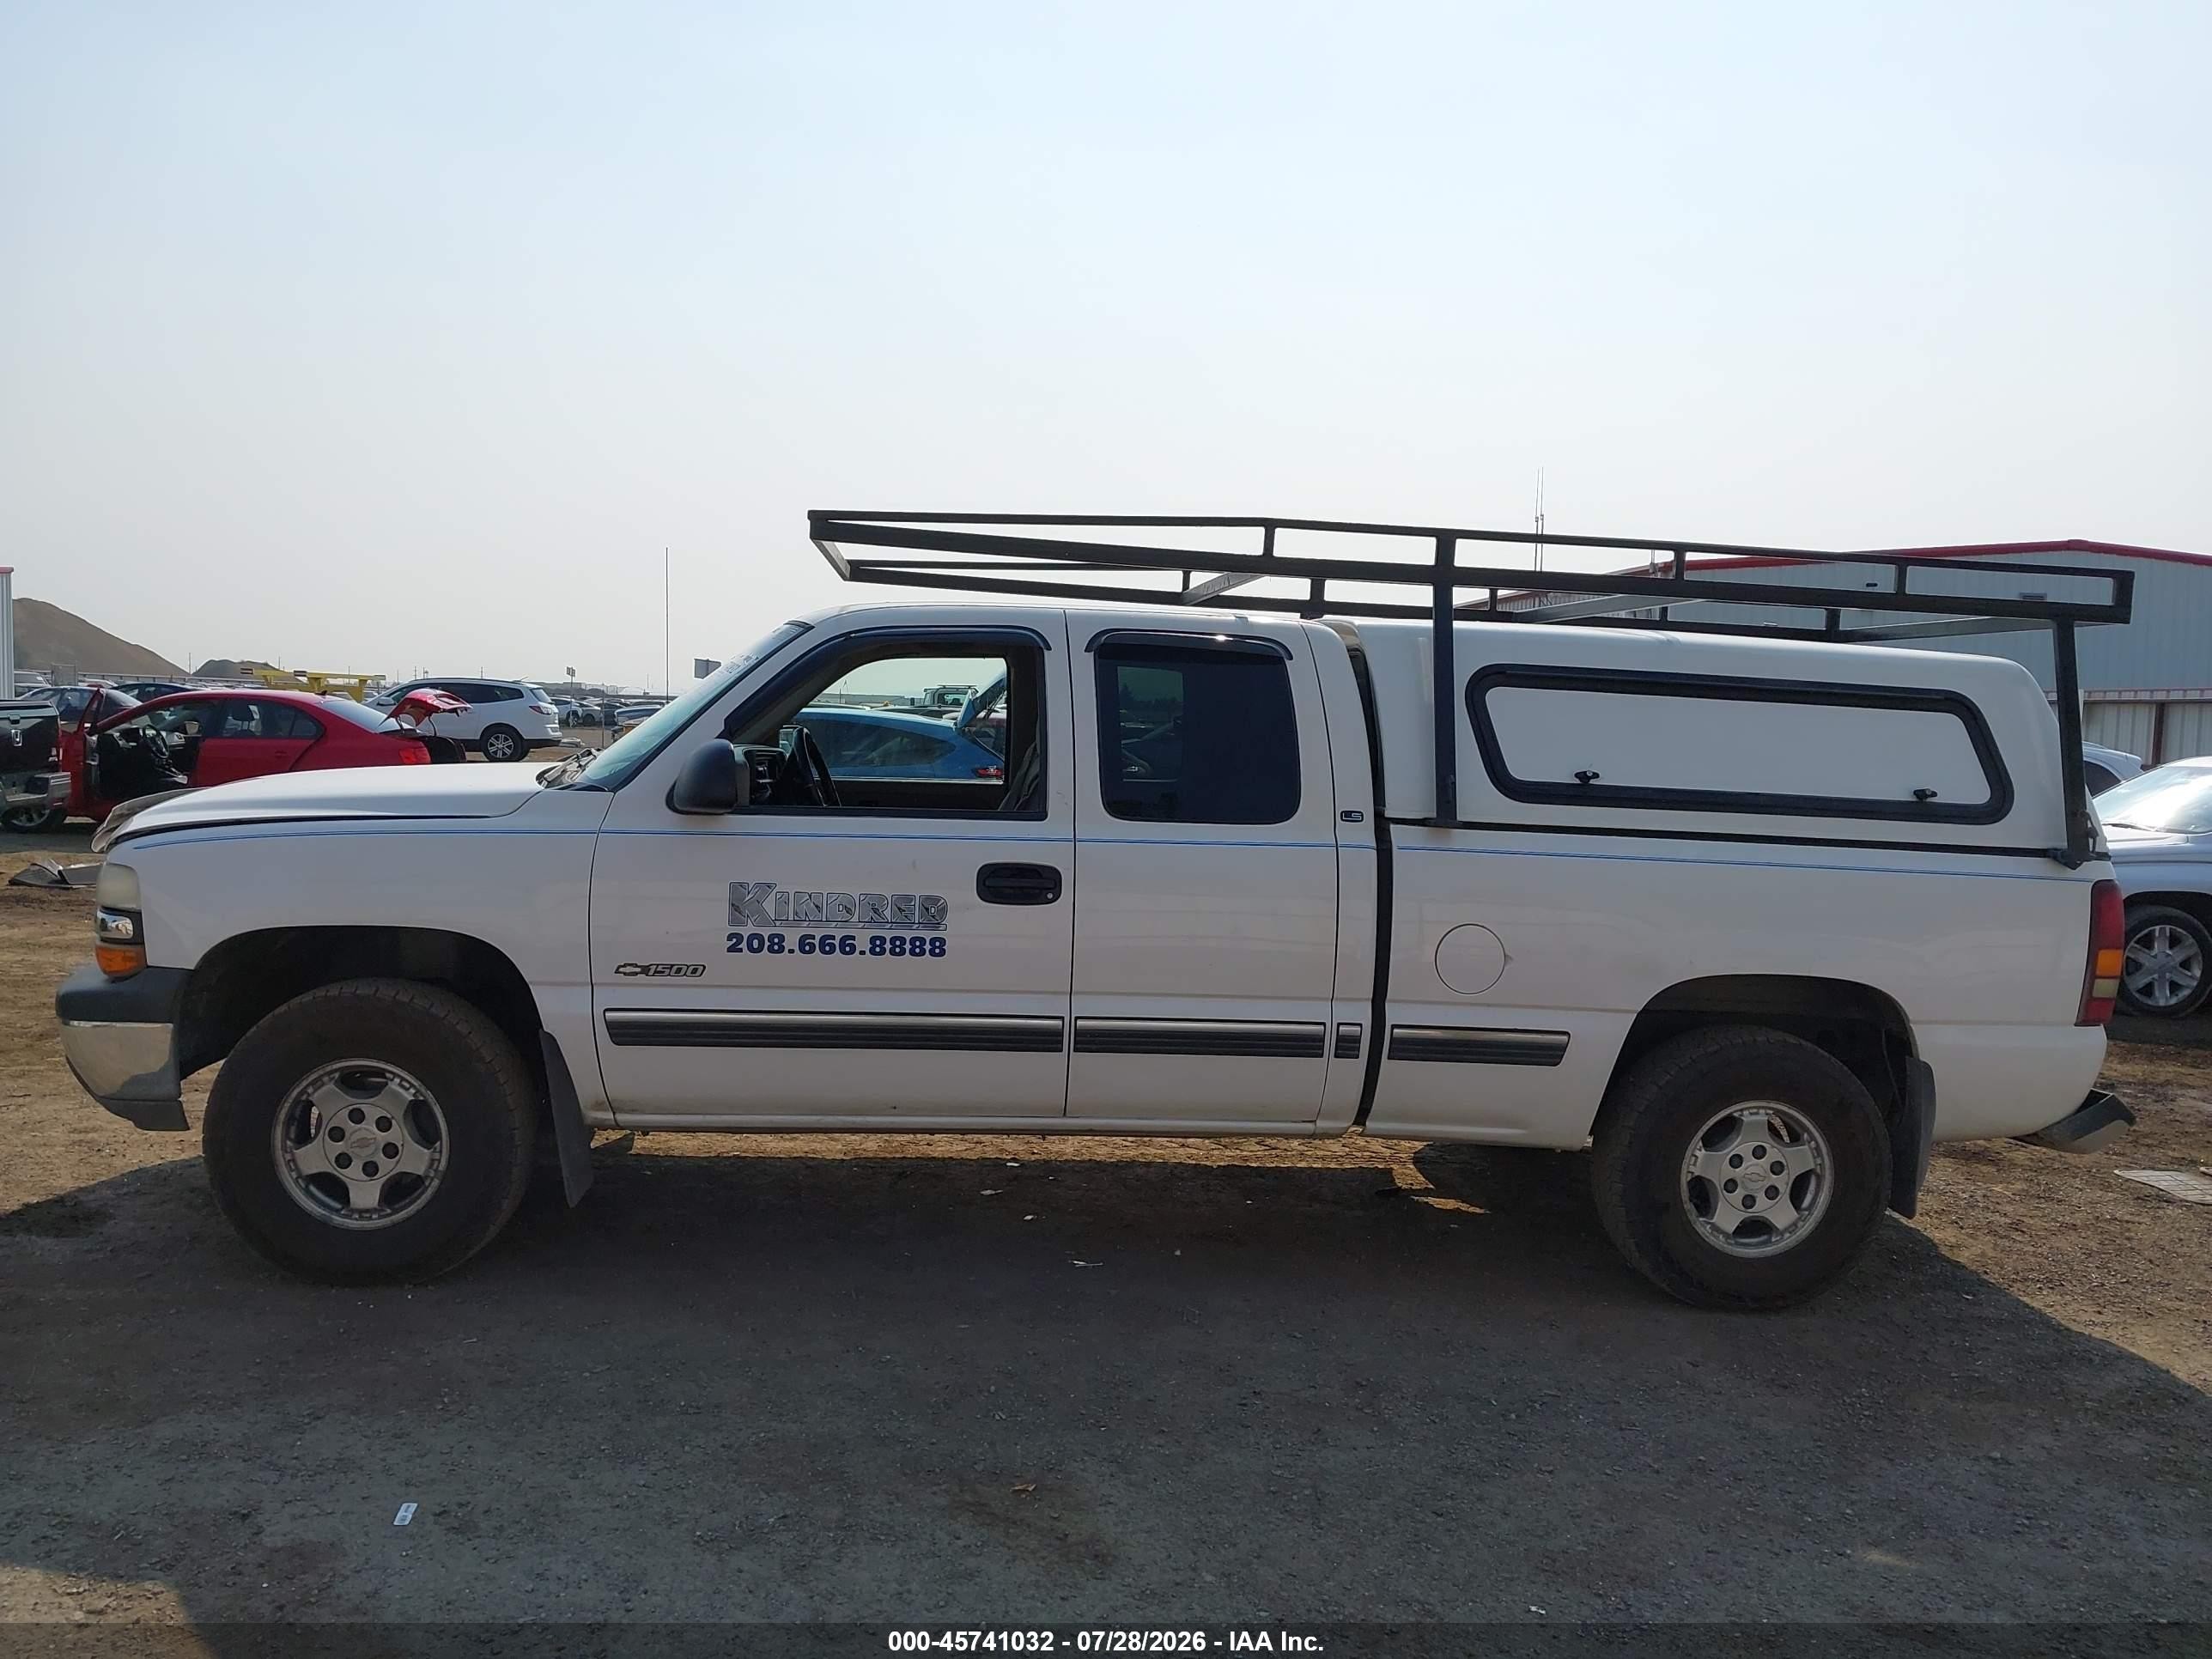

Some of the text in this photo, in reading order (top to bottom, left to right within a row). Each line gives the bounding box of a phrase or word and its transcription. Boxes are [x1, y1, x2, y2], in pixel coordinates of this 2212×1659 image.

[1342, 812, 1362, 821] LS
[728, 882, 948, 930] KINDRED
[726, 933, 947, 957] 208.666.8888
[647, 963, 705, 977] 1500
